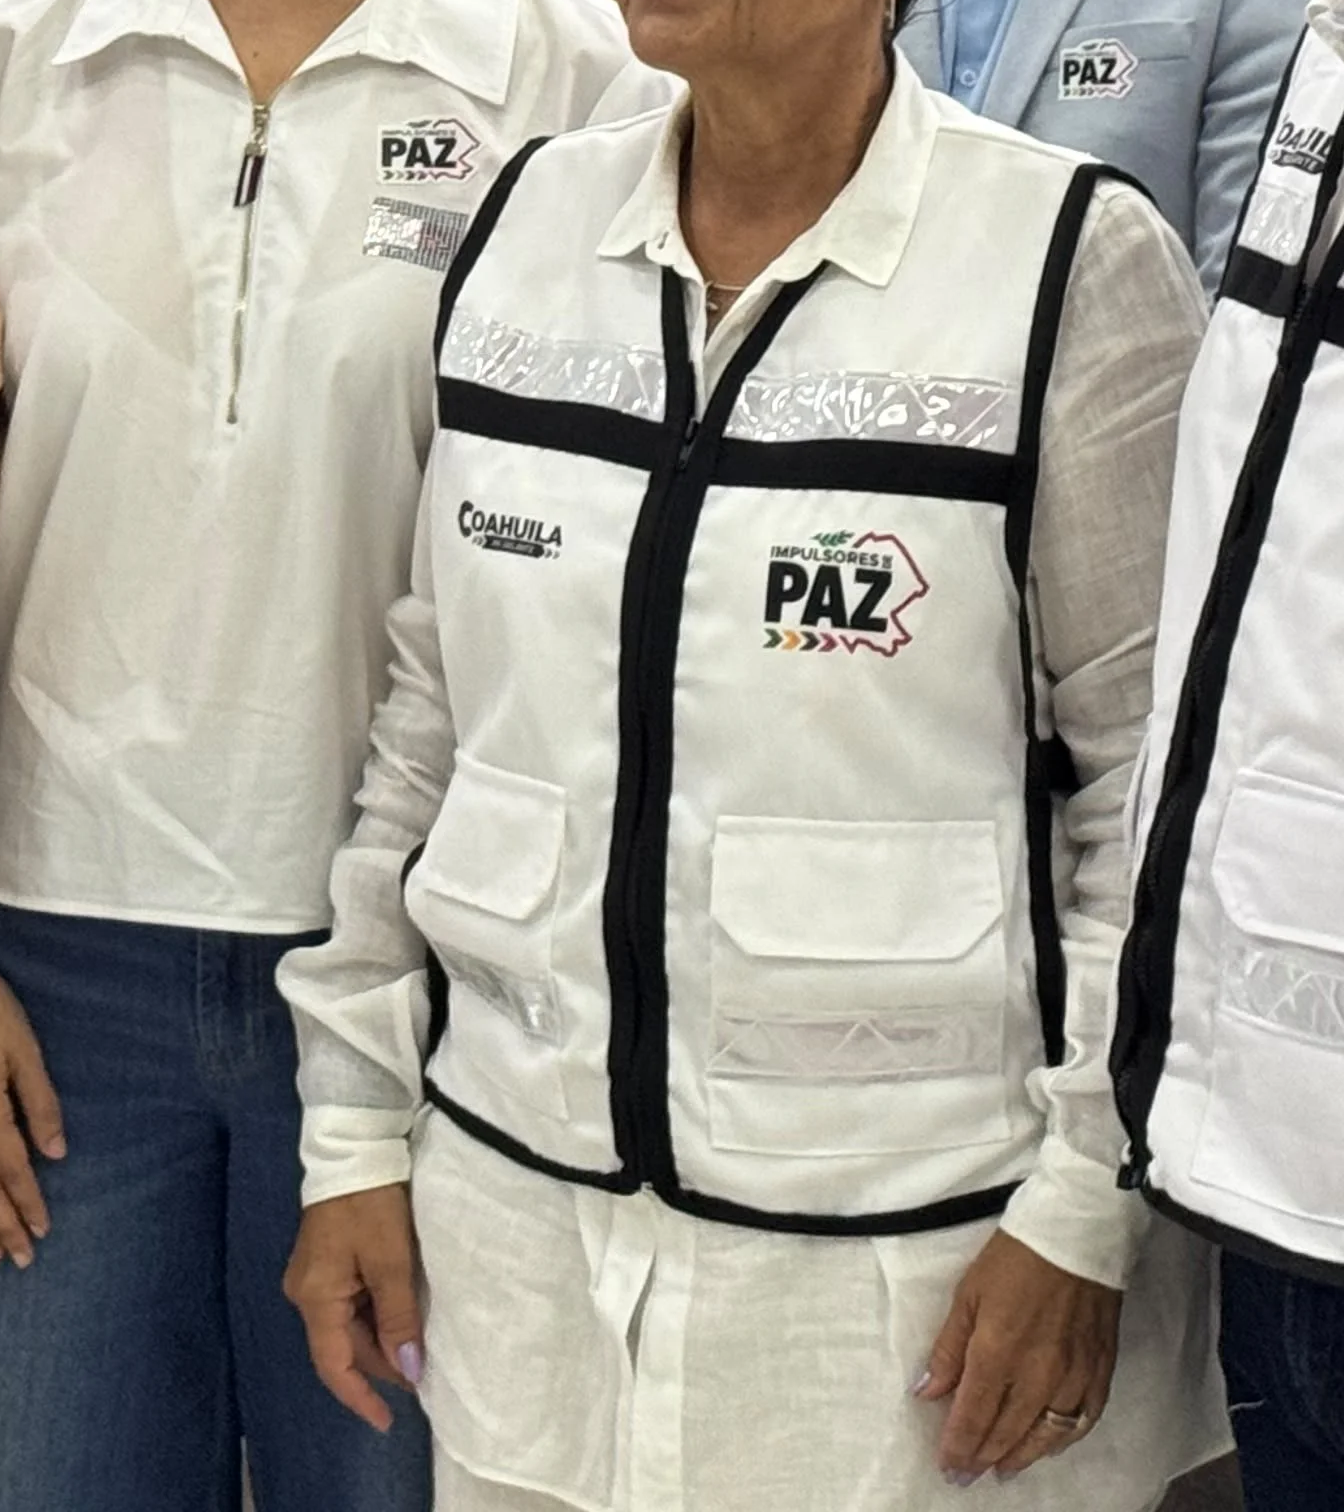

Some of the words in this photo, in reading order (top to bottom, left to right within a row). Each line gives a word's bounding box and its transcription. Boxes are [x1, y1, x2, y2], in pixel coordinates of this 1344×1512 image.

[1063, 57, 1117, 86] PAZ
[381, 137, 457, 168] PAZ
[458, 500, 562, 548] COAHUILA
[770, 545, 879, 567] IMPULSORES
[764, 560, 892, 633] PAZ
